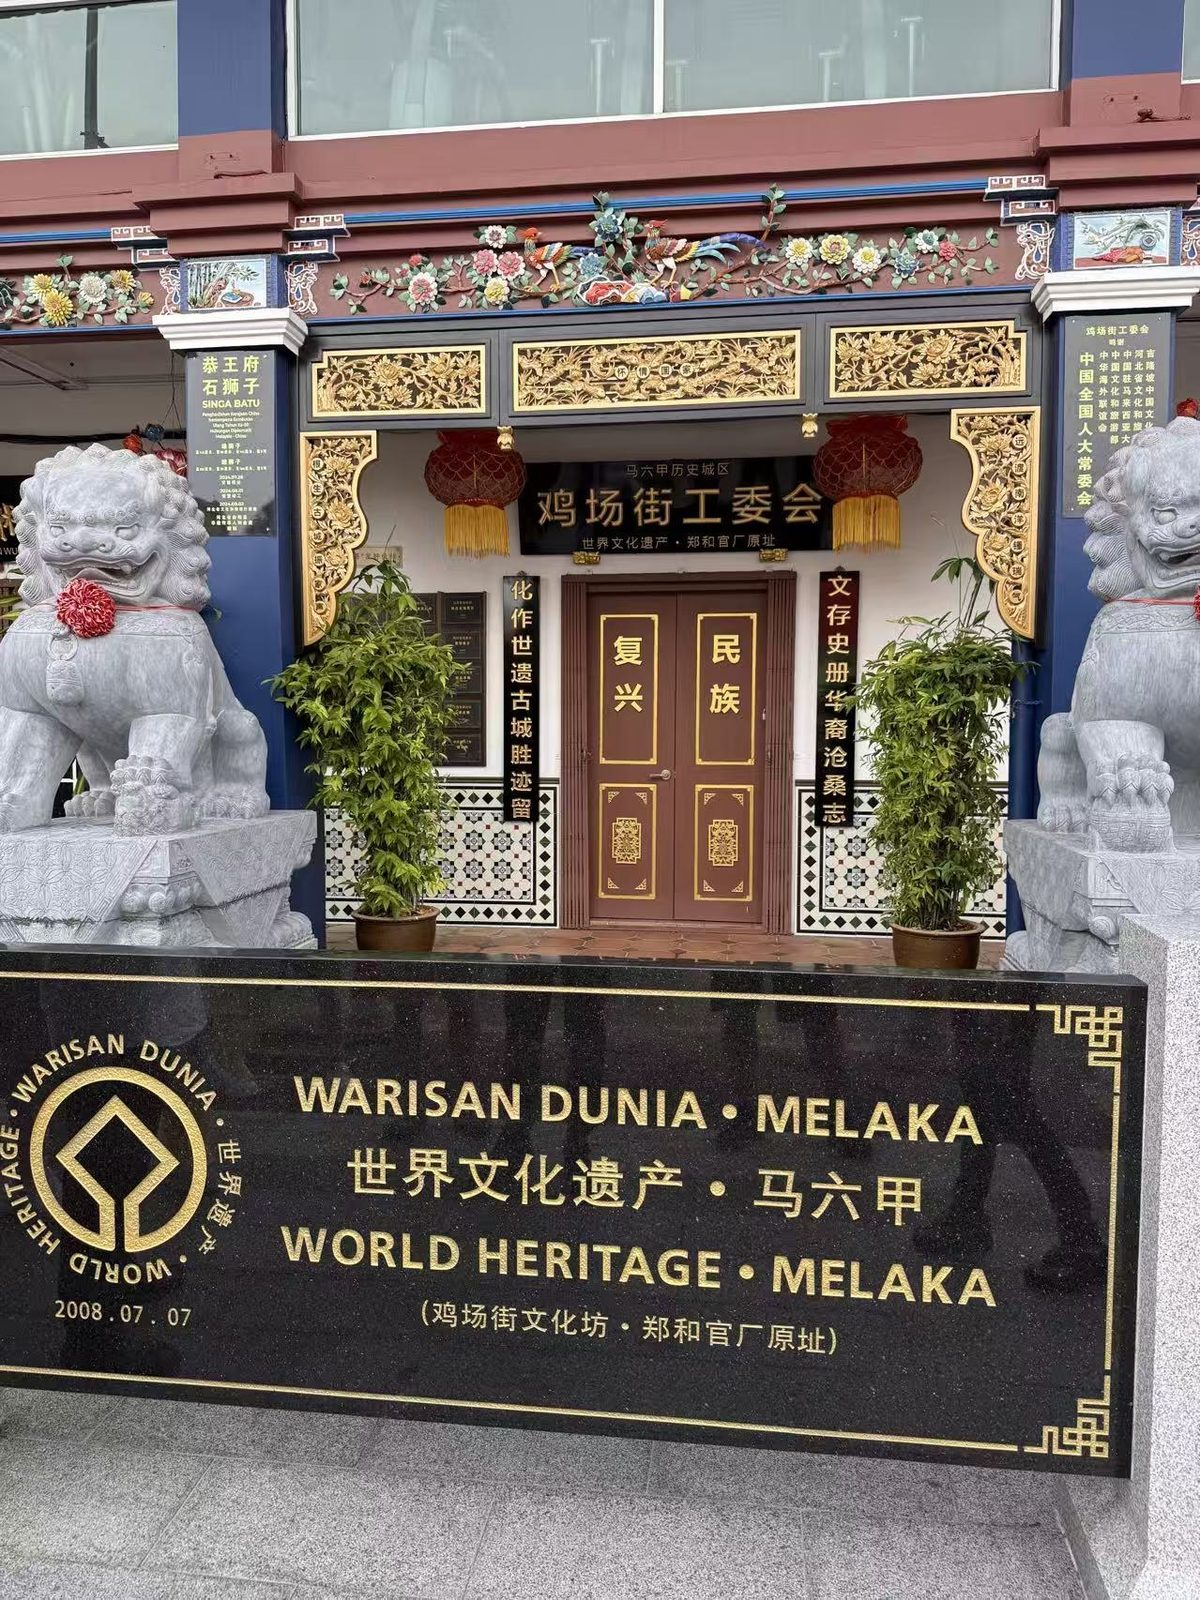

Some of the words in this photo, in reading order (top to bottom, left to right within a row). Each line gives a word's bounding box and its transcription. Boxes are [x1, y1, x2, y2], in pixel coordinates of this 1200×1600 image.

[202, 356, 260, 374] 恭王府
[1086, 325, 1149, 336] 鸡场街工委会
[202, 378, 260, 396] 石狮子
[202, 400, 232, 409] SINGA
[234, 399, 260, 408] BATU
[1077, 352, 1094, 506] 中国全国人大常委会
[537, 482, 823, 528] 鸡场街工委会
[626, 462, 729, 478] 马六甲历史城区
[510, 579, 534, 820] 化作世遗古城胜迹留
[613, 635, 644, 713] 复兴
[709, 633, 742, 714] 民族
[822, 575, 853, 824] 文存史册华裔沧桑志
[12, 1033, 125, 1104] WARISAN
[140, 1039, 218, 1112] DUNIA
[293, 1075, 521, 1121] WARISAN
[540, 1084, 708, 1130] DUNIA
[756, 1094, 984, 1145] MELAKA
[0, 1124, 61, 1255] HERITAGE
[198, 1138, 242, 1255] 世界遗产
[69, 1252, 172, 1285] WORLD
[280, 1226, 460, 1272] WORLD
[478, 1237, 722, 1289] HERITAGE
[772, 1255, 997, 1307] MELAKA
